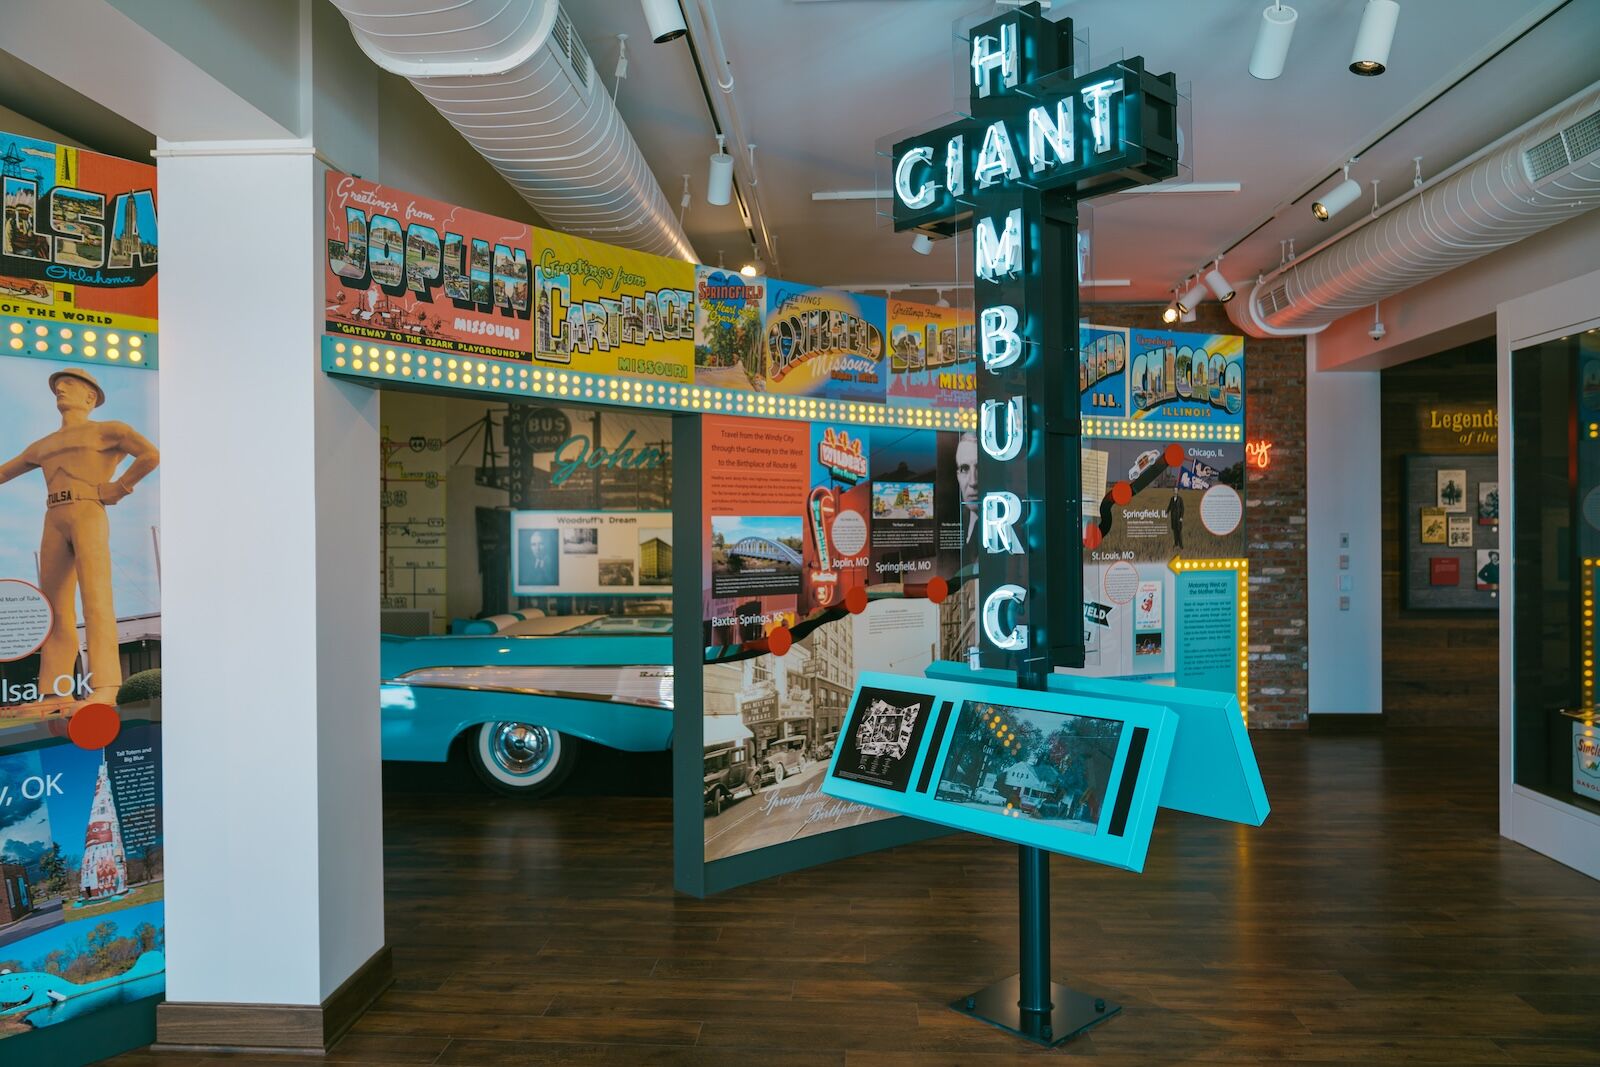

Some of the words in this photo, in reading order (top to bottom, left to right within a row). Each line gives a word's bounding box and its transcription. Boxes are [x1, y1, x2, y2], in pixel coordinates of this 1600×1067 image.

[895, 78, 1123, 210] GIANT
[336, 177, 398, 214] Greetings
[406, 200, 435, 224] from
[328, 206, 531, 320] JOPLIN
[540, 249, 613, 289] Greetings
[612, 267, 647, 292] from
[46, 265, 136, 284] Oklahoma
[698, 282, 763, 300] SPRINGFIELD
[1, 304, 20, 314] OF
[27, 307, 55, 318] THE
[63, 310, 113, 325] WORLD
[534, 265, 694, 362] CARTHAGE
[892, 303, 924, 320] Greetings
[452, 317, 521, 341] MISSOURI
[336, 323, 387, 340] "GATEWAY
[389, 332, 404, 341] TO
[405, 334, 423, 345] THE
[425, 338, 454, 350] OZARK
[458, 343, 527, 360] PLAYGROUNDS"
[768, 309, 886, 382] SPRINGFIELD
[618, 356, 689, 378] MISSOURI
[809, 355, 877, 377] Missouri
[1132, 346, 1242, 414] CHICAGO
[1093, 391, 1121, 408] ILL.
[1163, 407, 1212, 417] ILLINOIS
[1430, 410, 1499, 432] Legends
[529, 417, 566, 433] BUS
[721, 430, 739, 439] Travel
[740, 432, 754, 440] from
[765, 433, 783, 443] Windy
[784, 435, 795, 444] City
[1459, 432, 1475, 446] of
[1477, 432, 1498, 443] the
[712, 445, 735, 454] through
[747, 447, 771, 456] Gateway
[1188, 448, 1217, 459] Chicago,
[1218, 449, 1225, 457] IL
[736, 460, 765, 469] Birthplace
[48, 490, 71, 504] TULSA
[557, 516, 604, 524] Woodruff's
[1122, 509, 1160, 520] Springfield,
[831, 559, 854, 570] Joplin,
[855, 557, 870, 567] MO
[1092, 552, 1100, 561] St.
[1102, 552, 1121, 562] Louis,
[1122, 552, 1134, 560] MO
[875, 561, 917, 574] Springfield,
[917, 560, 931, 570] MO
[711, 616, 738, 628] Baxter
[739, 614, 772, 626] Springs,
[773, 611, 784, 622] KS
[53, 672, 94, 699] OK
[21, 773, 64, 801] OK
